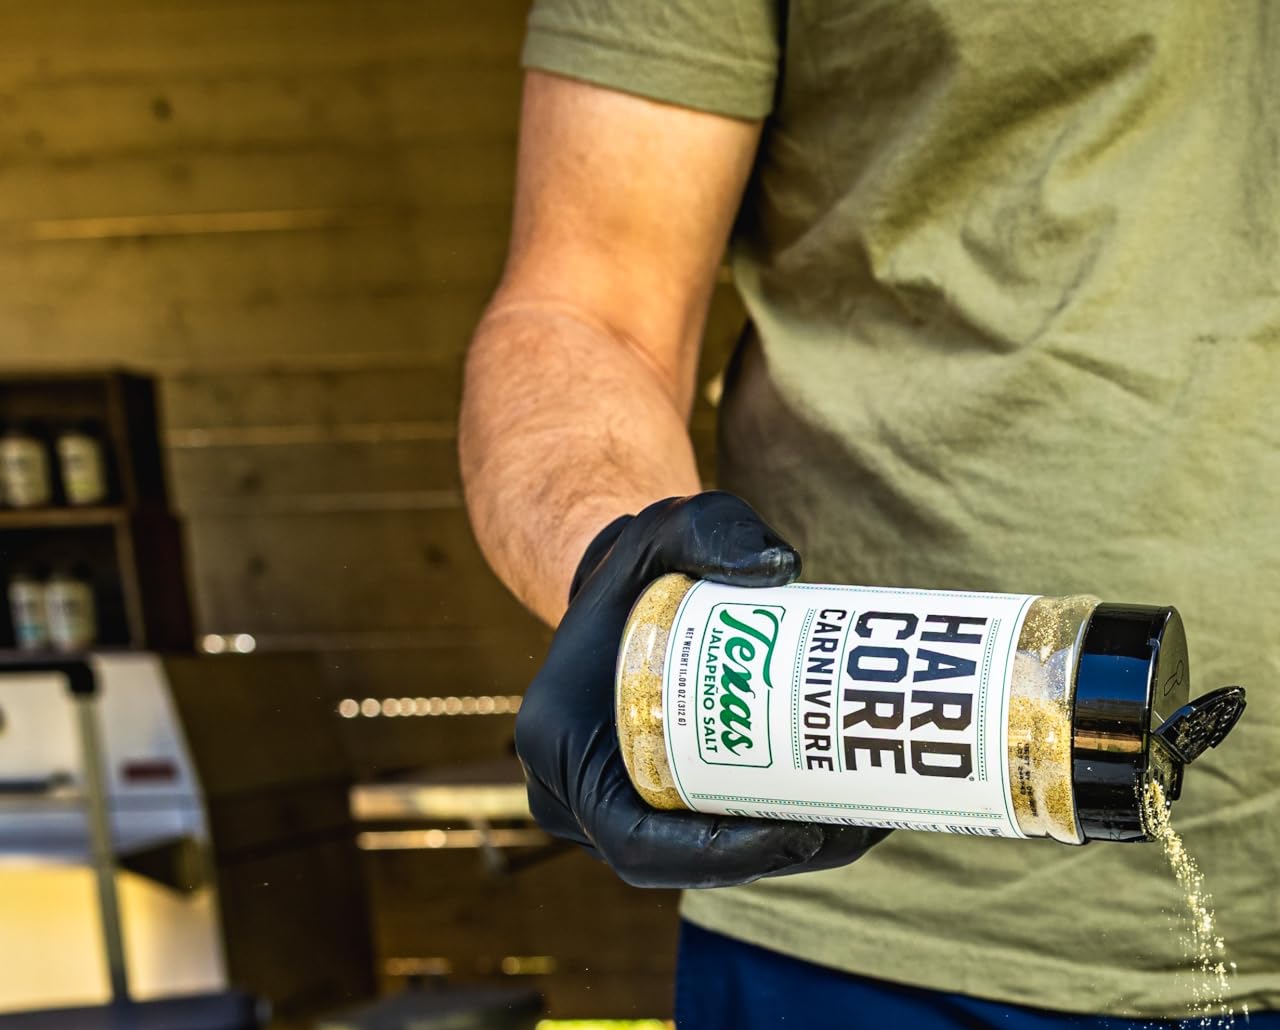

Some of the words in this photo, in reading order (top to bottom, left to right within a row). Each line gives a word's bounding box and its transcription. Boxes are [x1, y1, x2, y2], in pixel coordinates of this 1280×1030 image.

[681, 640, 692, 667] WEIGHT
[685, 627, 695, 639] NET
[678, 668, 687, 687] 11.00
[678, 688, 686, 699] OZ
[703, 628, 723, 710] JALAPEÑO
[719, 609, 779, 756] Texas
[804, 609, 847, 771] CARNIVORE
[843, 611, 919, 774] CORE
[910, 614, 988, 779] HARD
[703, 717, 718, 753] SALT
